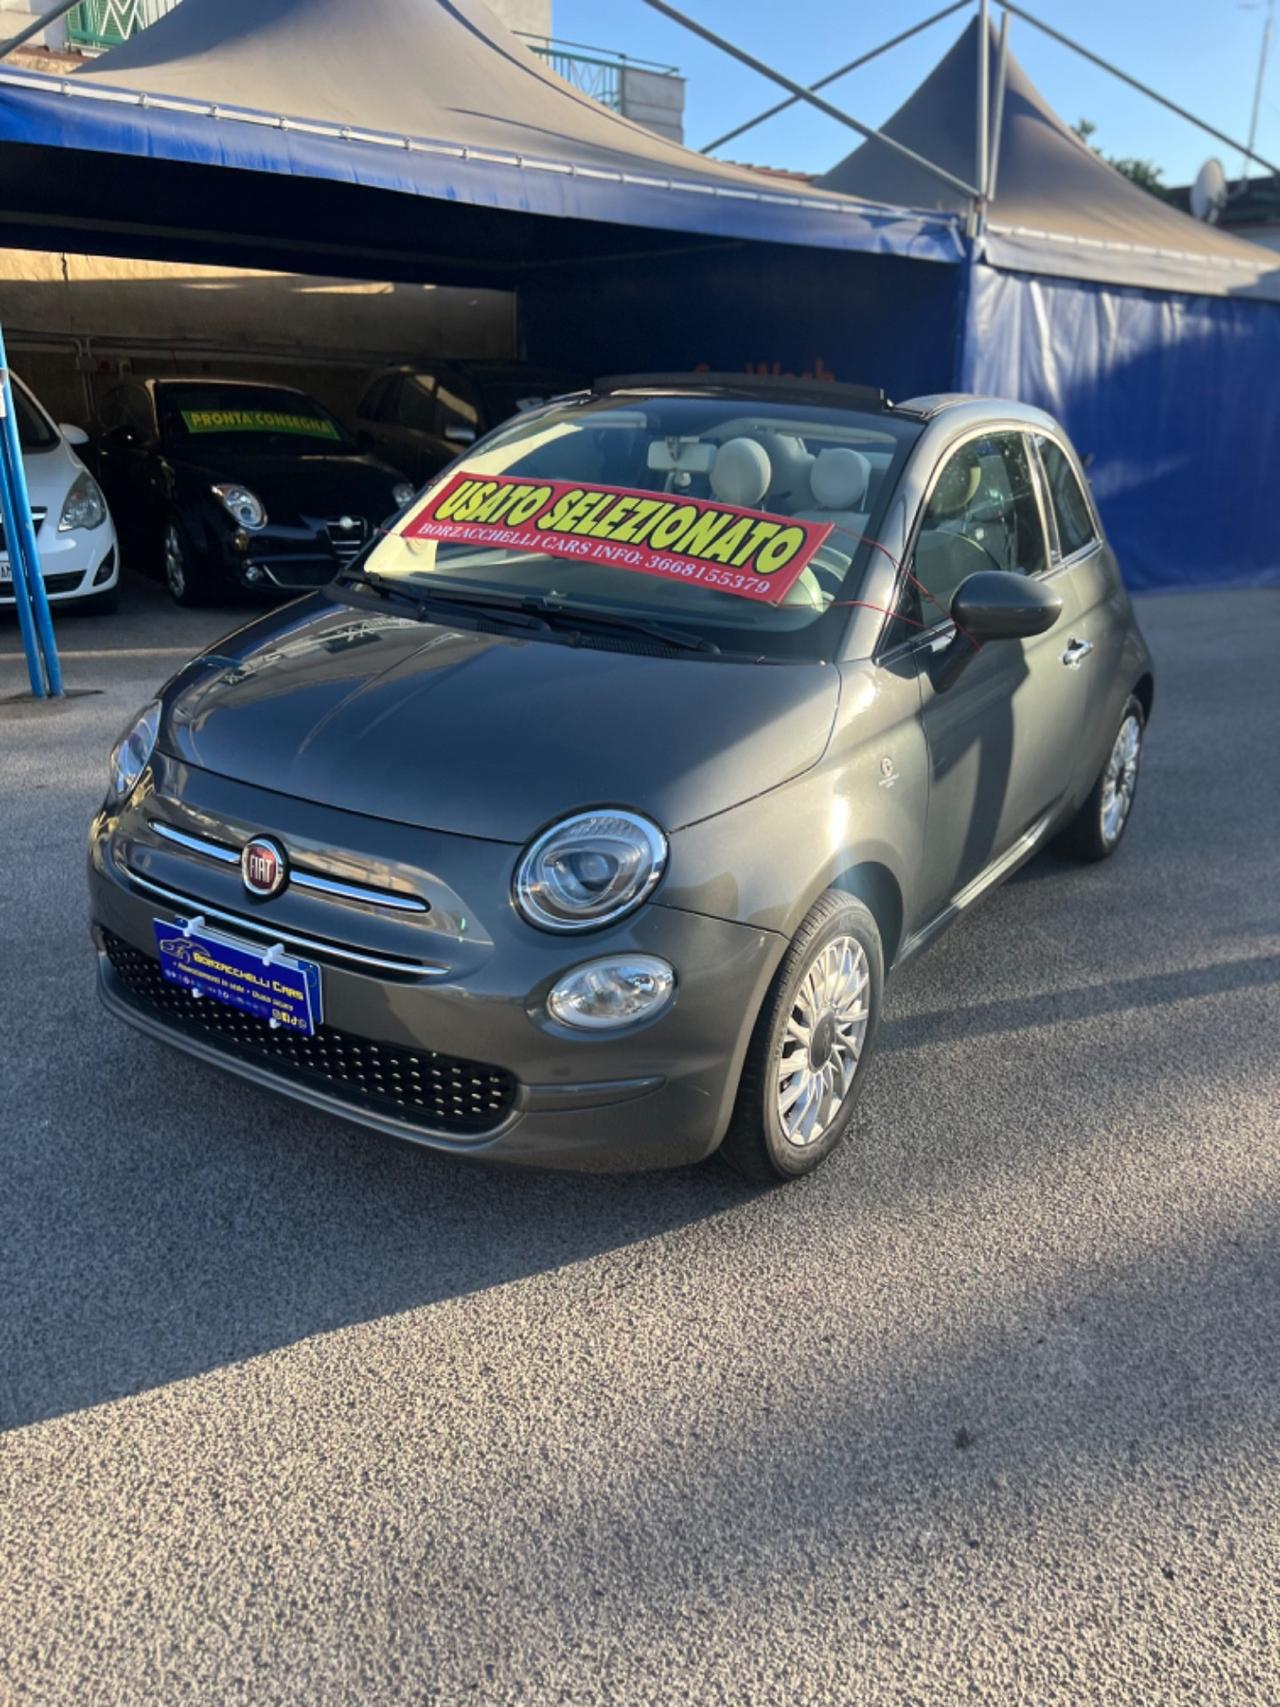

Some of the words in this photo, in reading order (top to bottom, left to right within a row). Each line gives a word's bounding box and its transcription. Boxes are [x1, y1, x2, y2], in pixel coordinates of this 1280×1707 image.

[191, 411, 251, 426] PRONTA
[255, 412, 331, 433] CONSEGNA
[433, 480, 552, 527] USATO
[536, 488, 806, 575] SELEZIONATO
[417, 522, 540, 547] BORZACCHELLI
[541, 535, 590, 555] CARS
[591, 543, 643, 566] INFO:
[644, 556, 771, 595] 3668155379
[250, 854, 272, 883] FIAT
